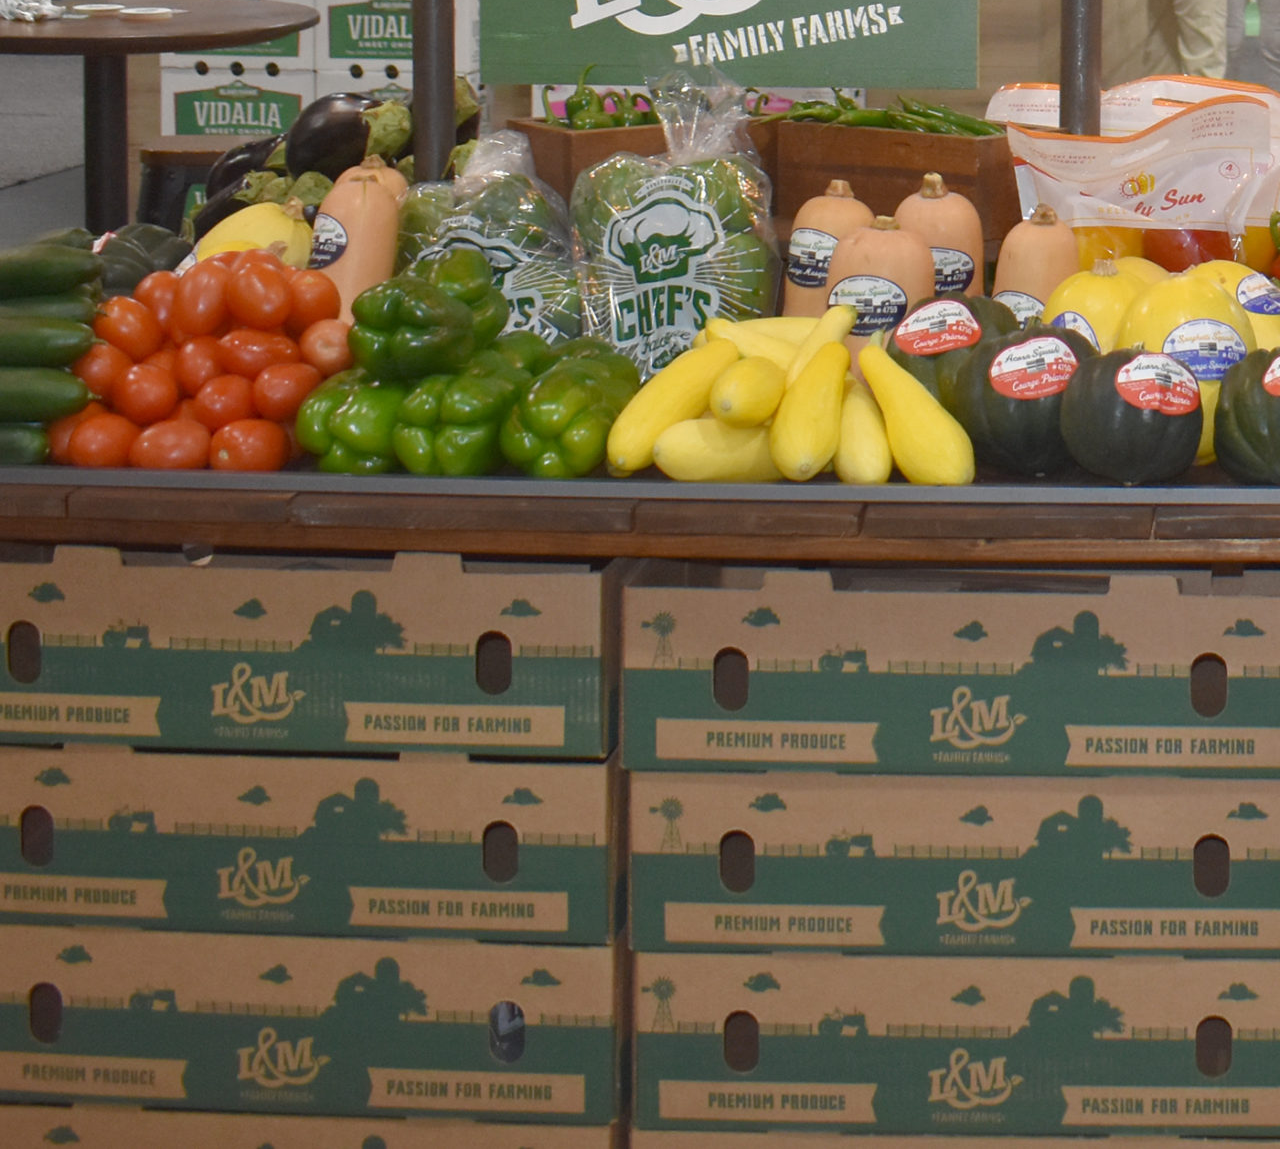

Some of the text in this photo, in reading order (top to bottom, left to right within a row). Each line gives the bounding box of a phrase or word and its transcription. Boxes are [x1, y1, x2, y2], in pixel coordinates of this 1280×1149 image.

[347, 14, 412, 40] VIDAL
[688, 2, 887, 67] FAMILY FARMS
[194, 101, 282, 129] VIDALIA
[1160, 188, 1206, 211] Sun
[640, 243, 682, 274] L&M
[617, 285, 711, 342] CHEF'S
[211, 662, 295, 724] L&M
[0, 704, 130, 724] PREMIUM PRODUCE
[364, 714, 532, 734] PASSION FOR FARMING
[930, 686, 1016, 750] L&M
[706, 731, 847, 751] PREMIUM PRODUCE
[1085, 737, 1256, 756] PASSION FOR FARMING
[217, 847, 299, 908] L&M
[3, 884, 137, 906] PREMIUM PRODUCE
[937, 870, 1022, 932] L&M
[368, 898, 535, 919] PASSION FOR FARMING
[714, 915, 853, 933] PREMIUM PRODUCE
[1090, 919, 1260, 937] PASSION FOR FARMING
[237, 1027, 318, 1089] L&M
[22, 1063, 156, 1086] PREMIUM PRODUCE
[928, 1049, 1014, 1110] L&M
[386, 1079, 553, 1101] PASSION FOR FARMING
[708, 1093, 846, 1111] PREMIUM PRODUCE
[1081, 1097, 1251, 1117] PASSION FOR FARMING
